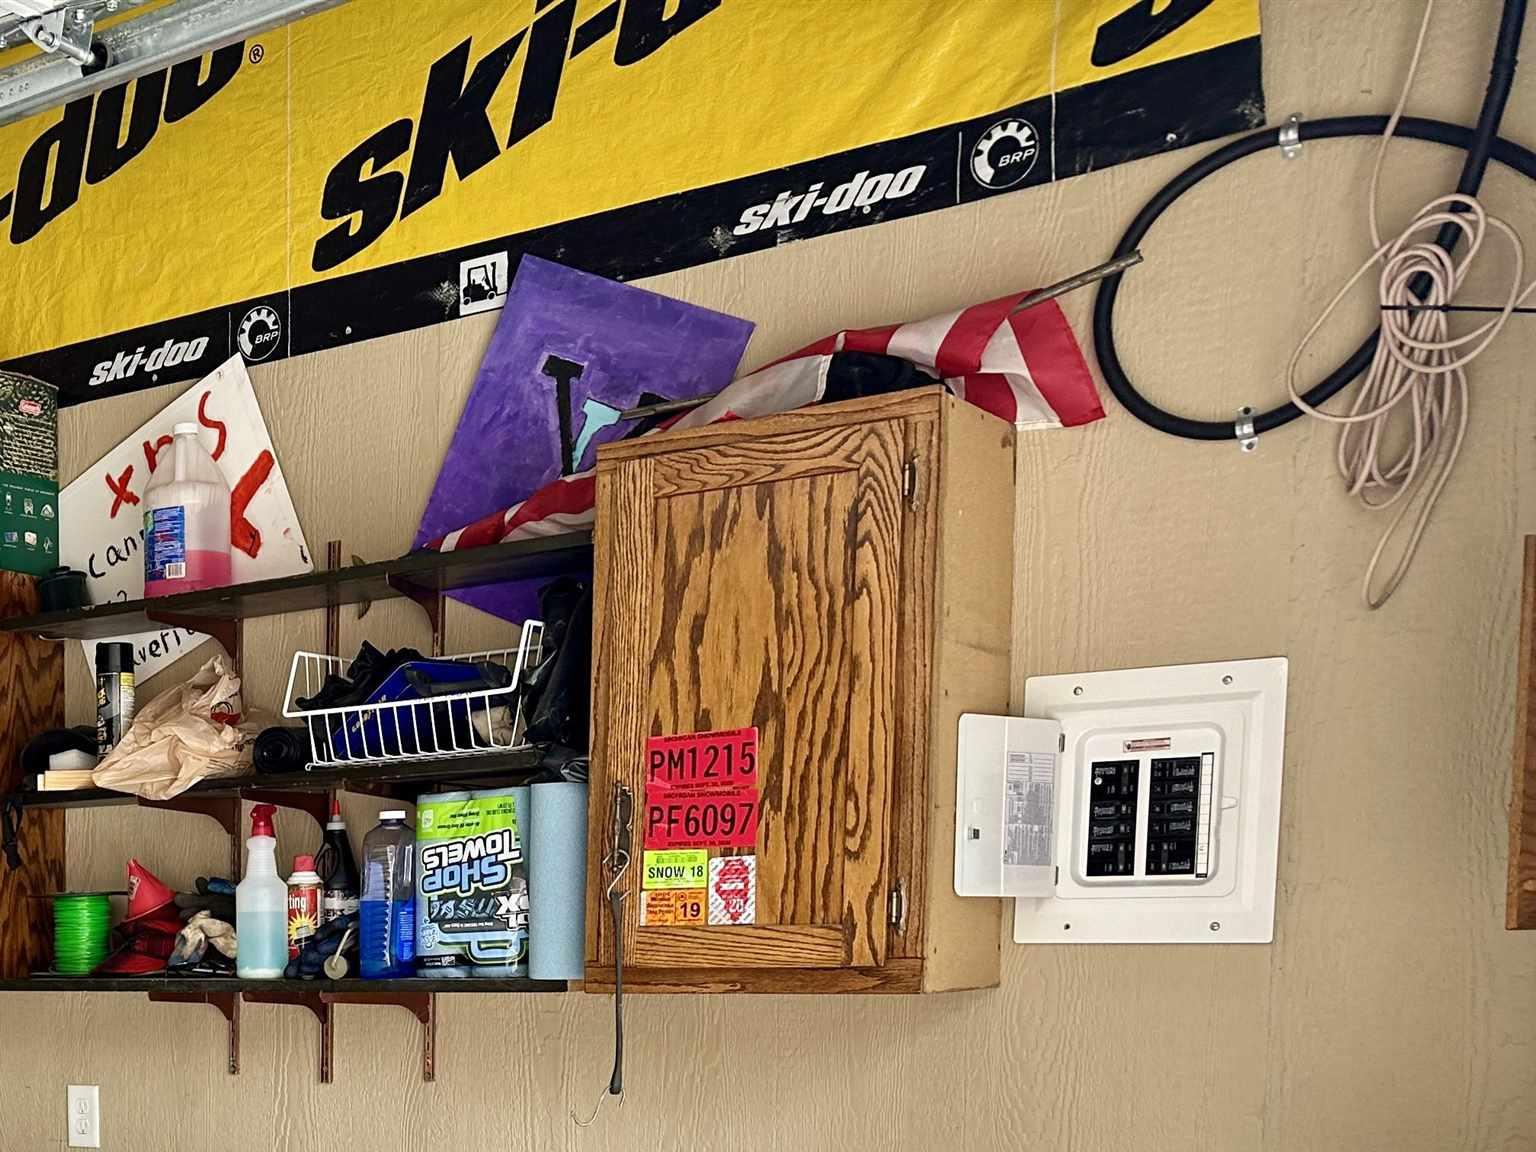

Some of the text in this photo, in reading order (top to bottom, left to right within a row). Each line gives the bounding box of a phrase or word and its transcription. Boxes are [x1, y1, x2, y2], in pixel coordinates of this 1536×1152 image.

[997, 147, 1036, 168] BRP
[733, 165, 928, 237] ski-doo
[255, 331, 280, 345] BRP
[89, 335, 210, 387] ski-doo
[649, 741, 756, 783] PM1215
[648, 803, 755, 838] PF6097
[422, 829, 521, 870] TOWELS
[422, 855, 507, 896] SHOP
[648, 865, 704, 879] SNOW 18
[288, 894, 307, 911] ting
[680, 902, 701, 918] 19
